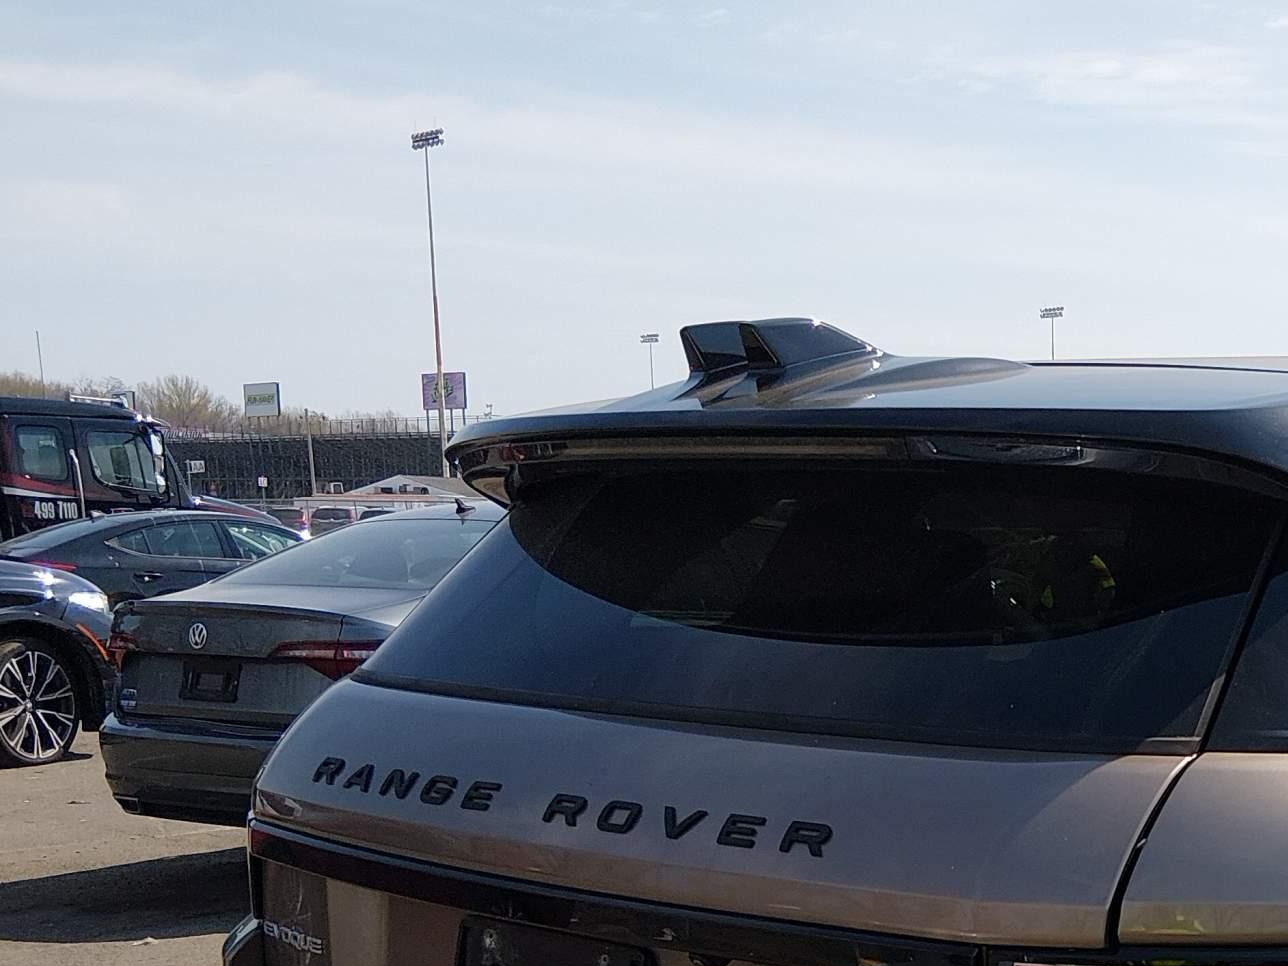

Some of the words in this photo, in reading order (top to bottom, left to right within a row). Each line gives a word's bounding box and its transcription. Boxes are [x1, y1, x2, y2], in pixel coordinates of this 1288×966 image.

[34, 501, 56, 519] 499
[57, 501, 79, 519] 7110
[312, 756, 503, 812] RANGE
[542, 793, 834, 859] ROVER
[263, 920, 322, 955] EVOQUE
